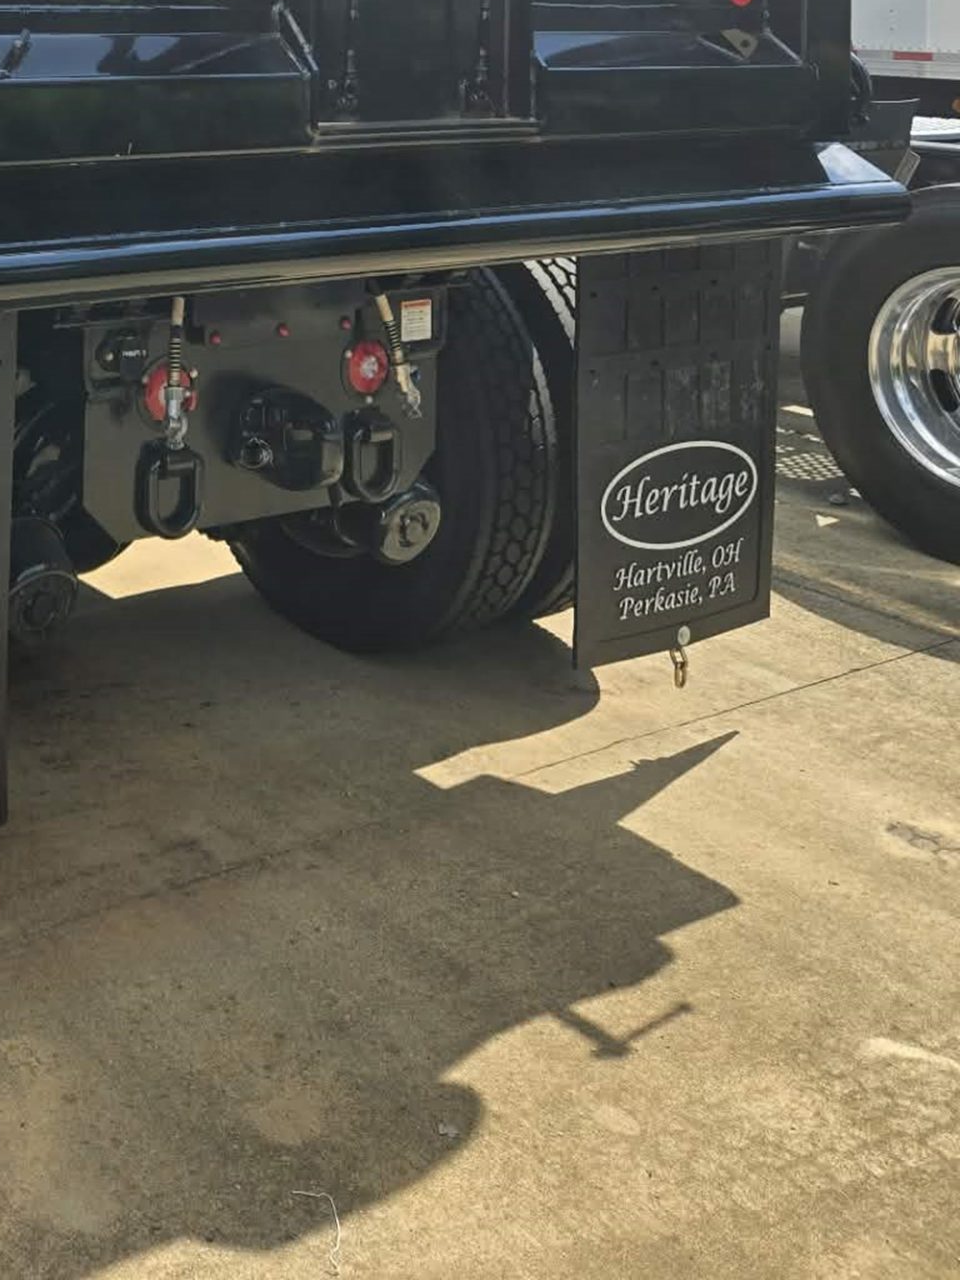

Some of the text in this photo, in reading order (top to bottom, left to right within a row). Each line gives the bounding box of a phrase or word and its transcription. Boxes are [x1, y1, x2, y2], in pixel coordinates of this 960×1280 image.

[612, 470, 749, 521] Heritage
[613, 537, 745, 591] Hartville, OH
[619, 572, 736, 620] Perkasie, PA
